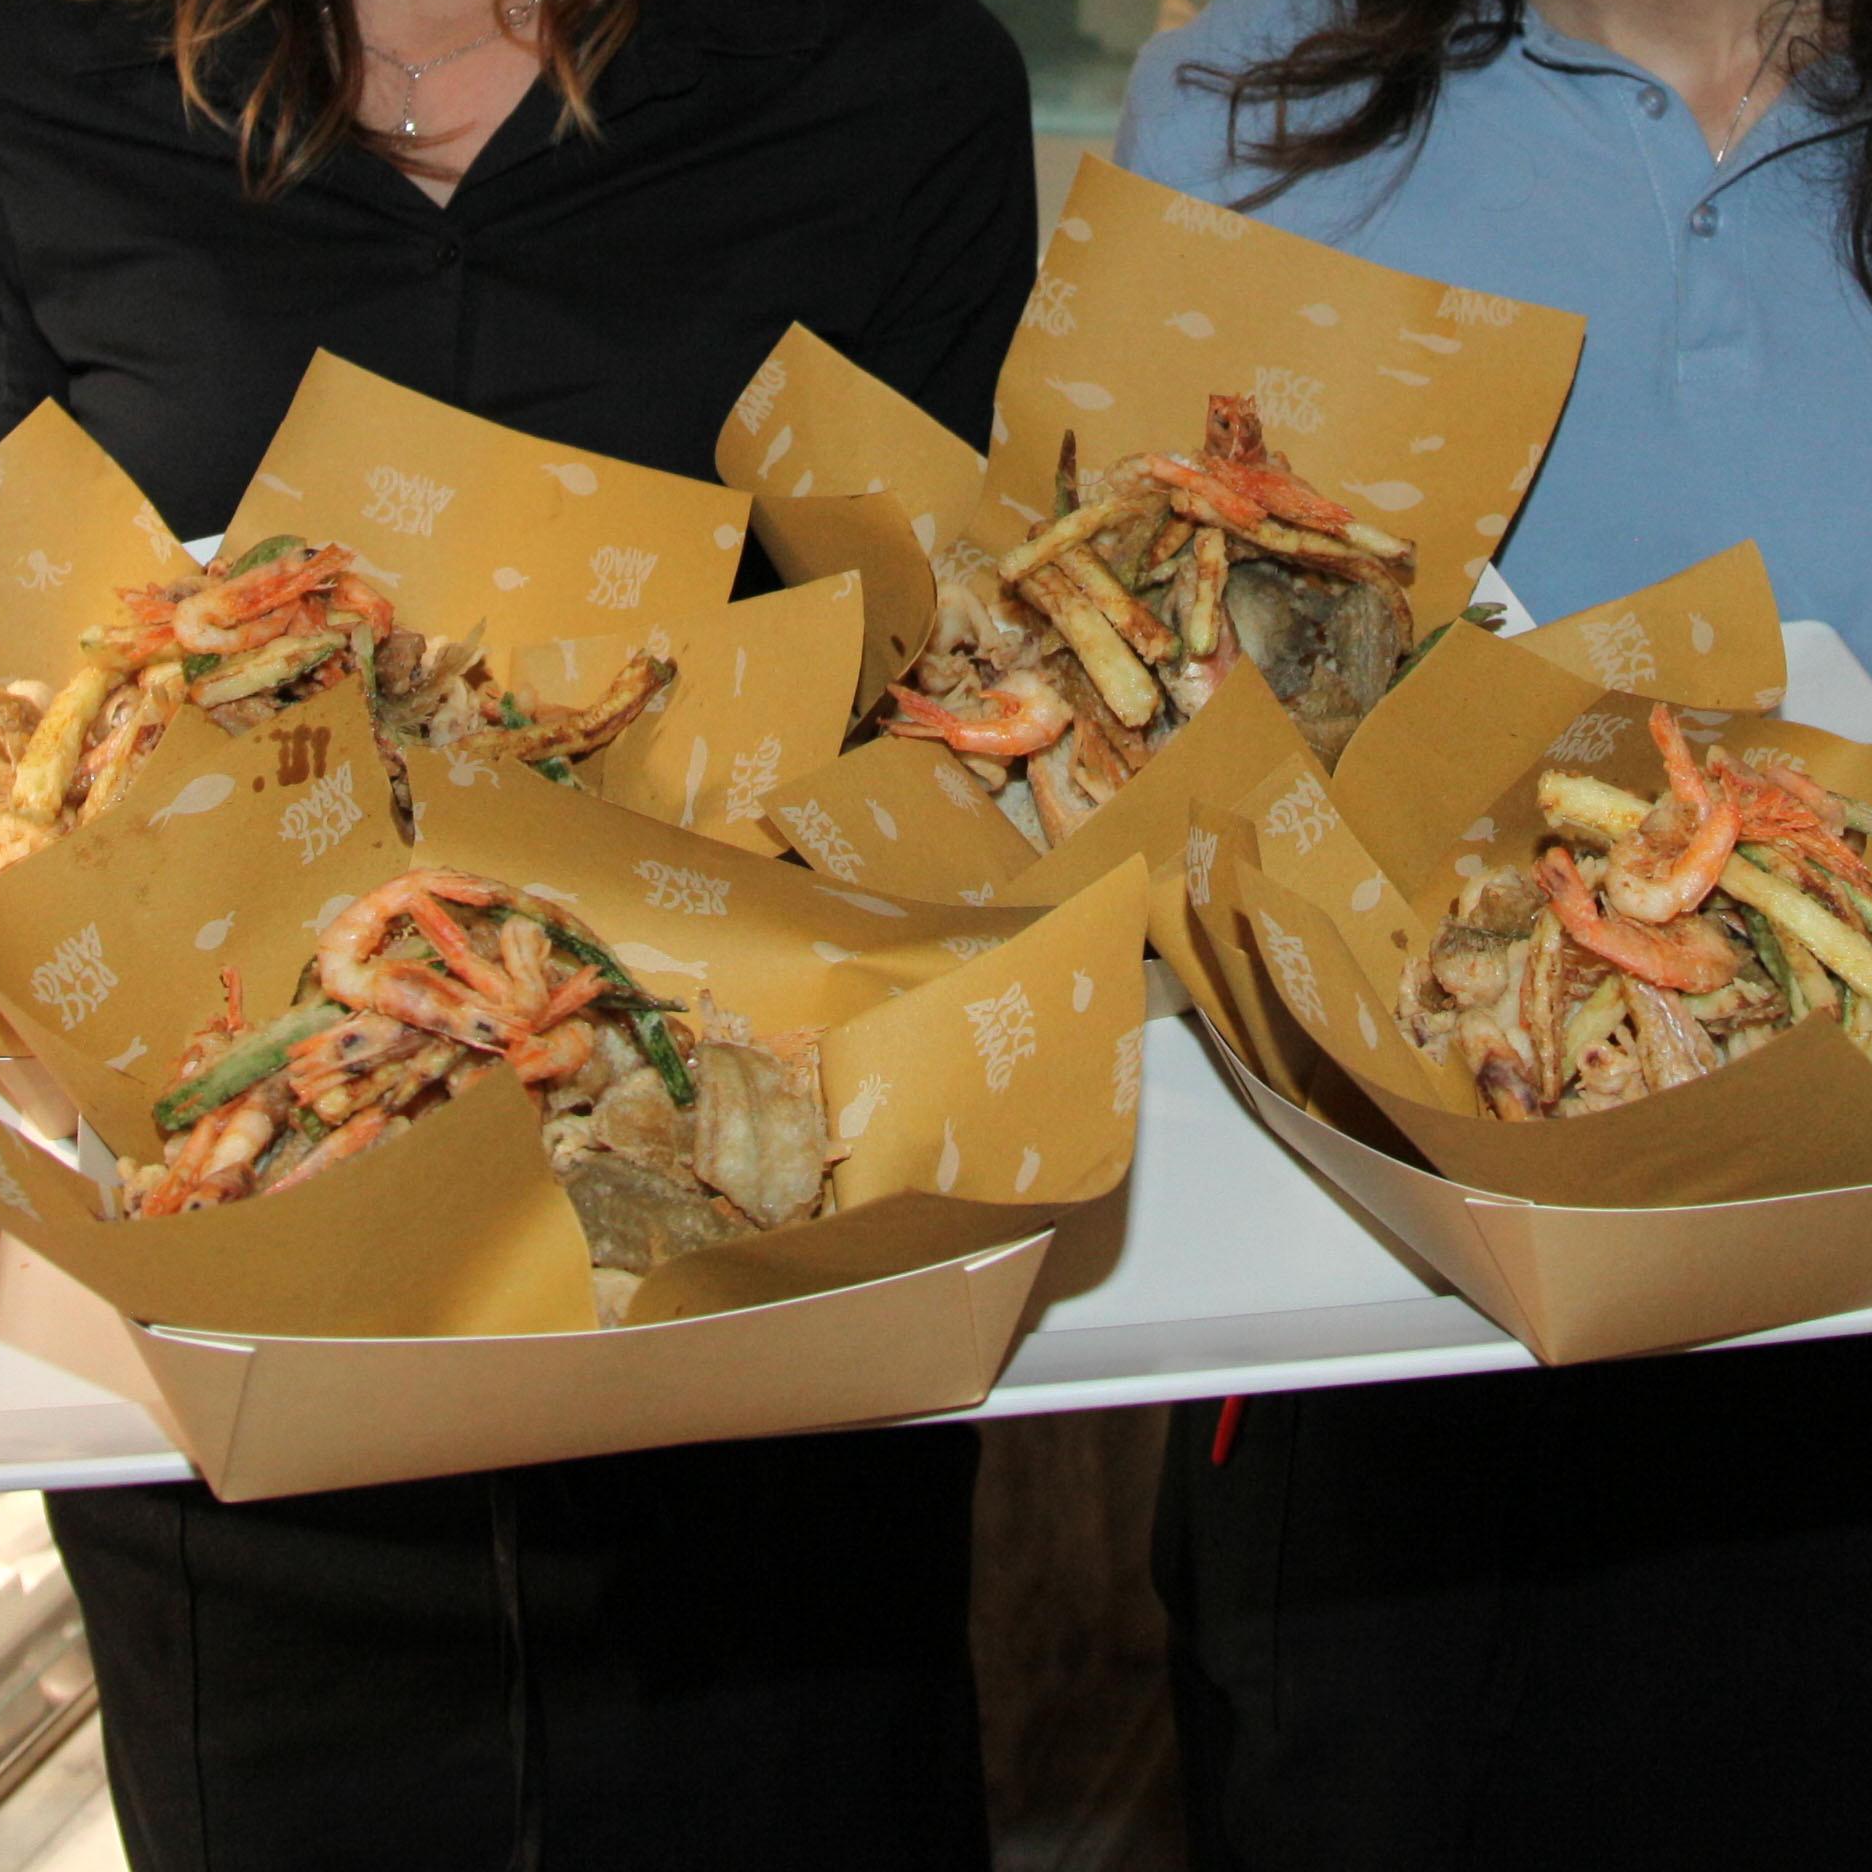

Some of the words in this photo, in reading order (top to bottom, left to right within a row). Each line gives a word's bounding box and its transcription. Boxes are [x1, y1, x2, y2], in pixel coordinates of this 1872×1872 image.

[1255, 366, 1327, 401] PESCE
[360, 495, 433, 537] PESCE
[364, 464, 457, 514] BARACCA
[585, 576, 641, 610] PESCE
[588, 544, 659, 585] BARACCA
[1614, 611, 1656, 682] PESCE
[278, 759, 354, 843] BARACCA
[726, 751, 754, 825] PESCE
[301, 794, 364, 865] PESCE
[779, 806, 860, 885] BARACCA
[803, 798, 866, 867] PESCE
[632, 859, 731, 897] BARACCA
[644, 878, 728, 917] PESCE
[31, 921, 104, 1004] BARACCA
[59, 962, 120, 1031] PESCE
[963, 997, 1014, 1095] BARACCA
[994, 980, 1037, 1063] PESCE
